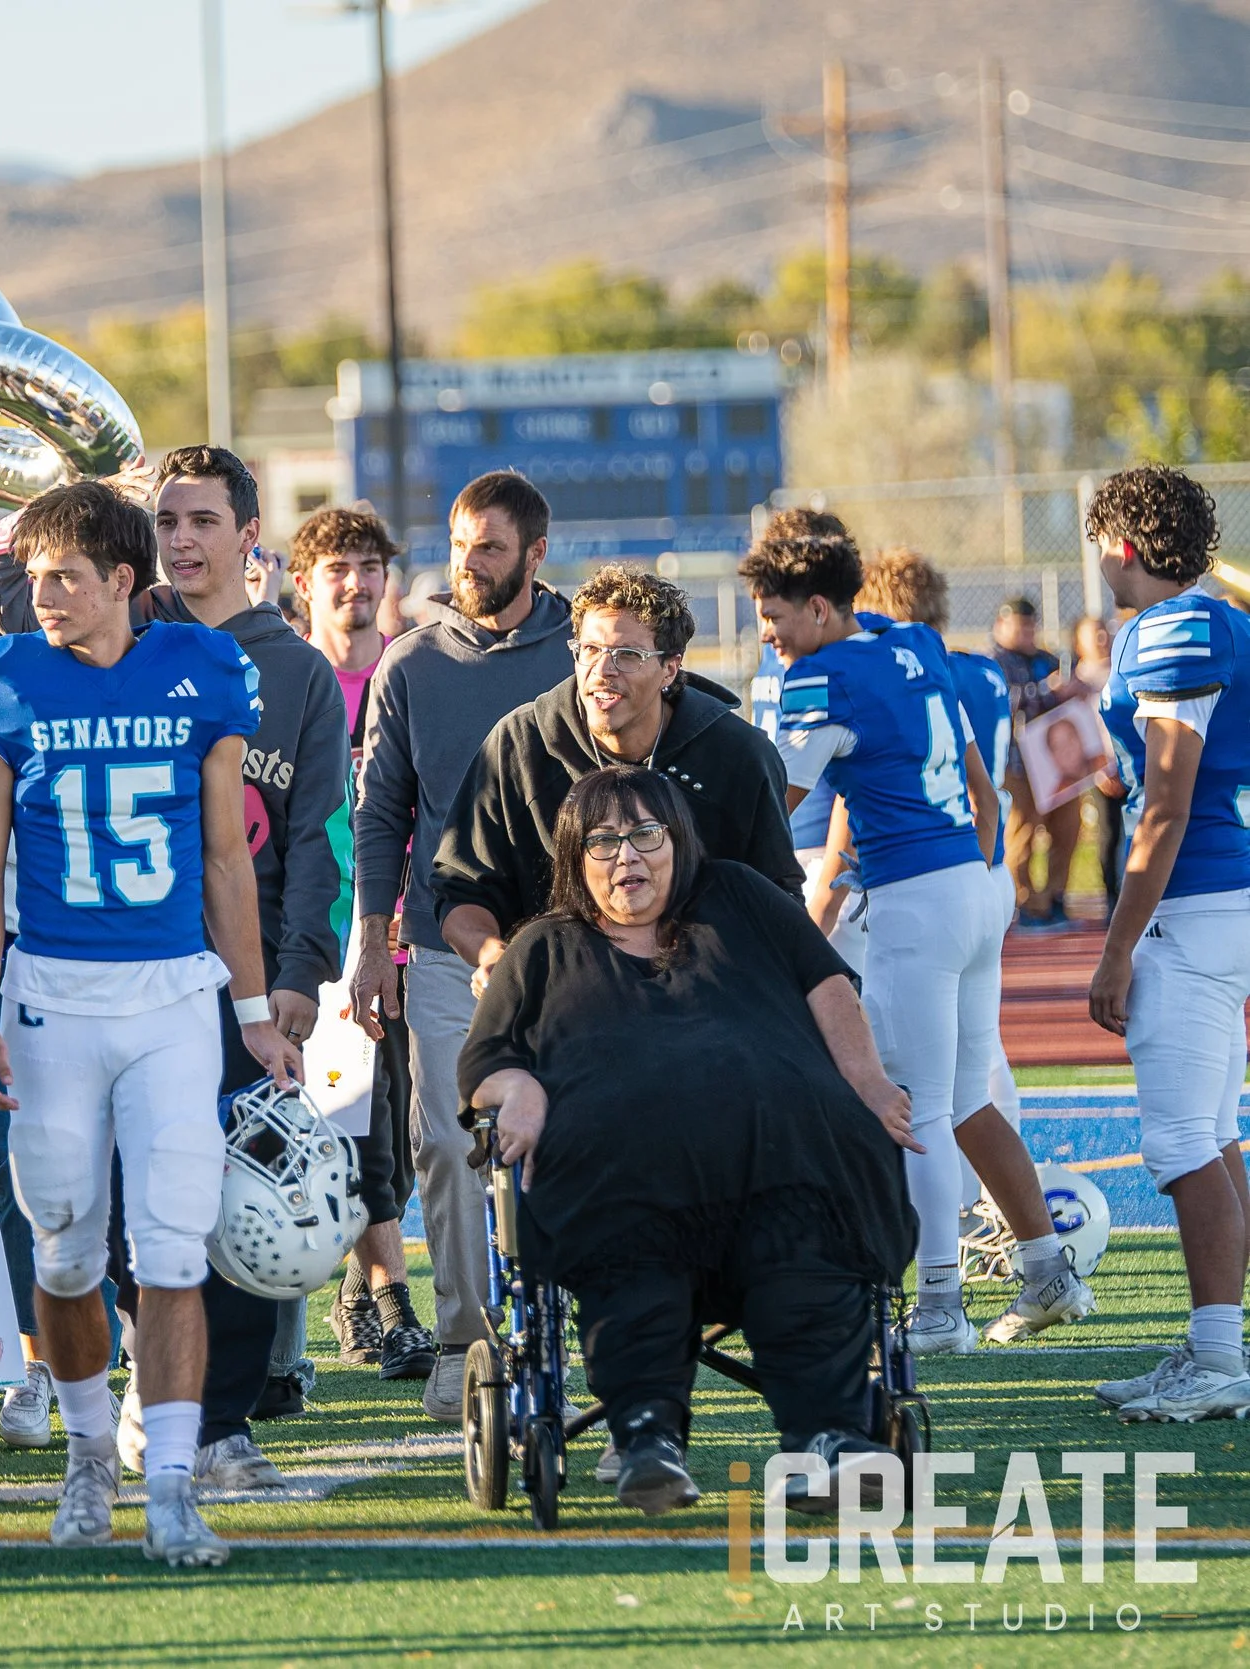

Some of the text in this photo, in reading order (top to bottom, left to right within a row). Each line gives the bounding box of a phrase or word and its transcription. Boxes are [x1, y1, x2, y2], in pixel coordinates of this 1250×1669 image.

[29, 715, 193, 751] SENATORS
[50, 760, 177, 908] 15
[1039, 1276, 1065, 1310] NIKE
